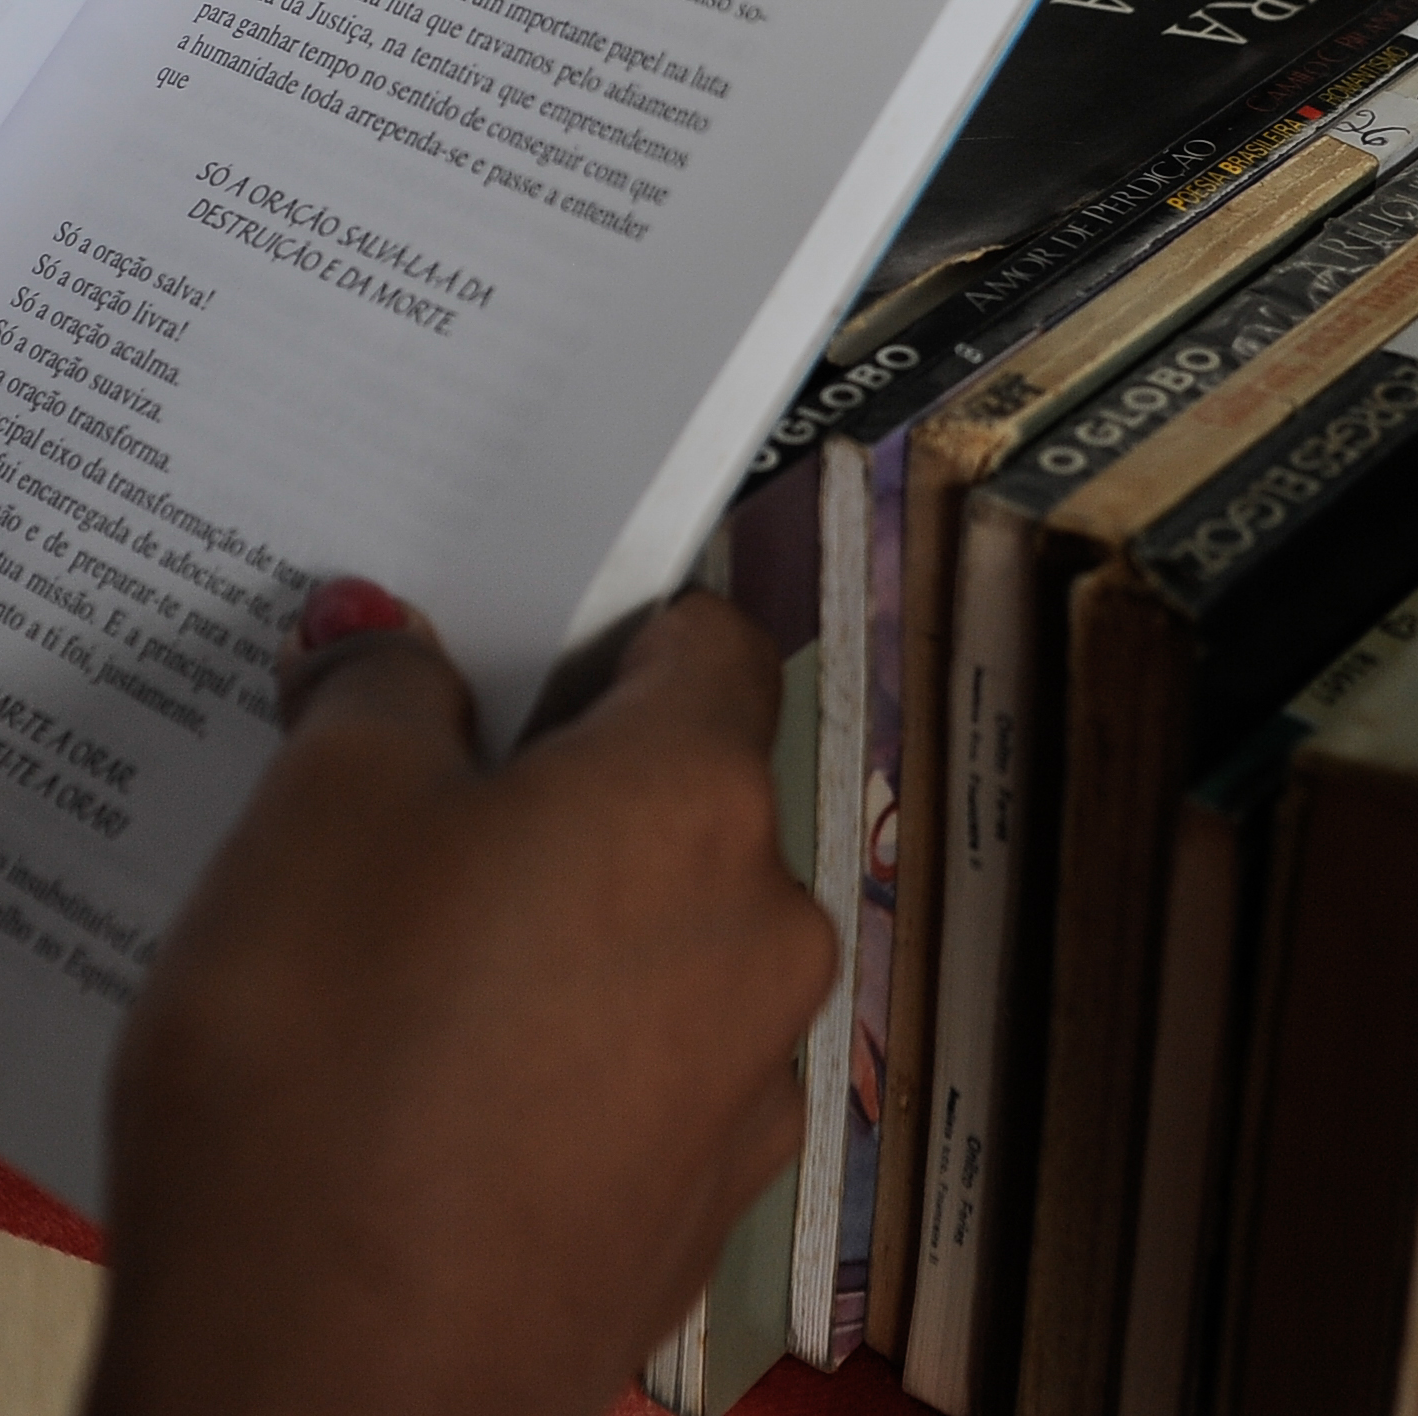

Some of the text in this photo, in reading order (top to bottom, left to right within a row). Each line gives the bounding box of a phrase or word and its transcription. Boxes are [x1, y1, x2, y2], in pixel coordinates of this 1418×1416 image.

[1166, 170, 1228, 213] POESIA
[1219, 116, 1307, 178] BRASILEIRA
[1319, 44, 1410, 107] ROMANTISMO
[51, 220, 216, 311] Só a oração salva!
[964, 245, 1063, 313] AMOR
[1062, 218, 1100, 263] DE
[1081, 137, 1218, 229] PERDIÇÃO
[779, 342, 921, 447] GLOBO
[1037, 445, 1087, 476] O
[1074, 345, 1223, 450] GLOBO
